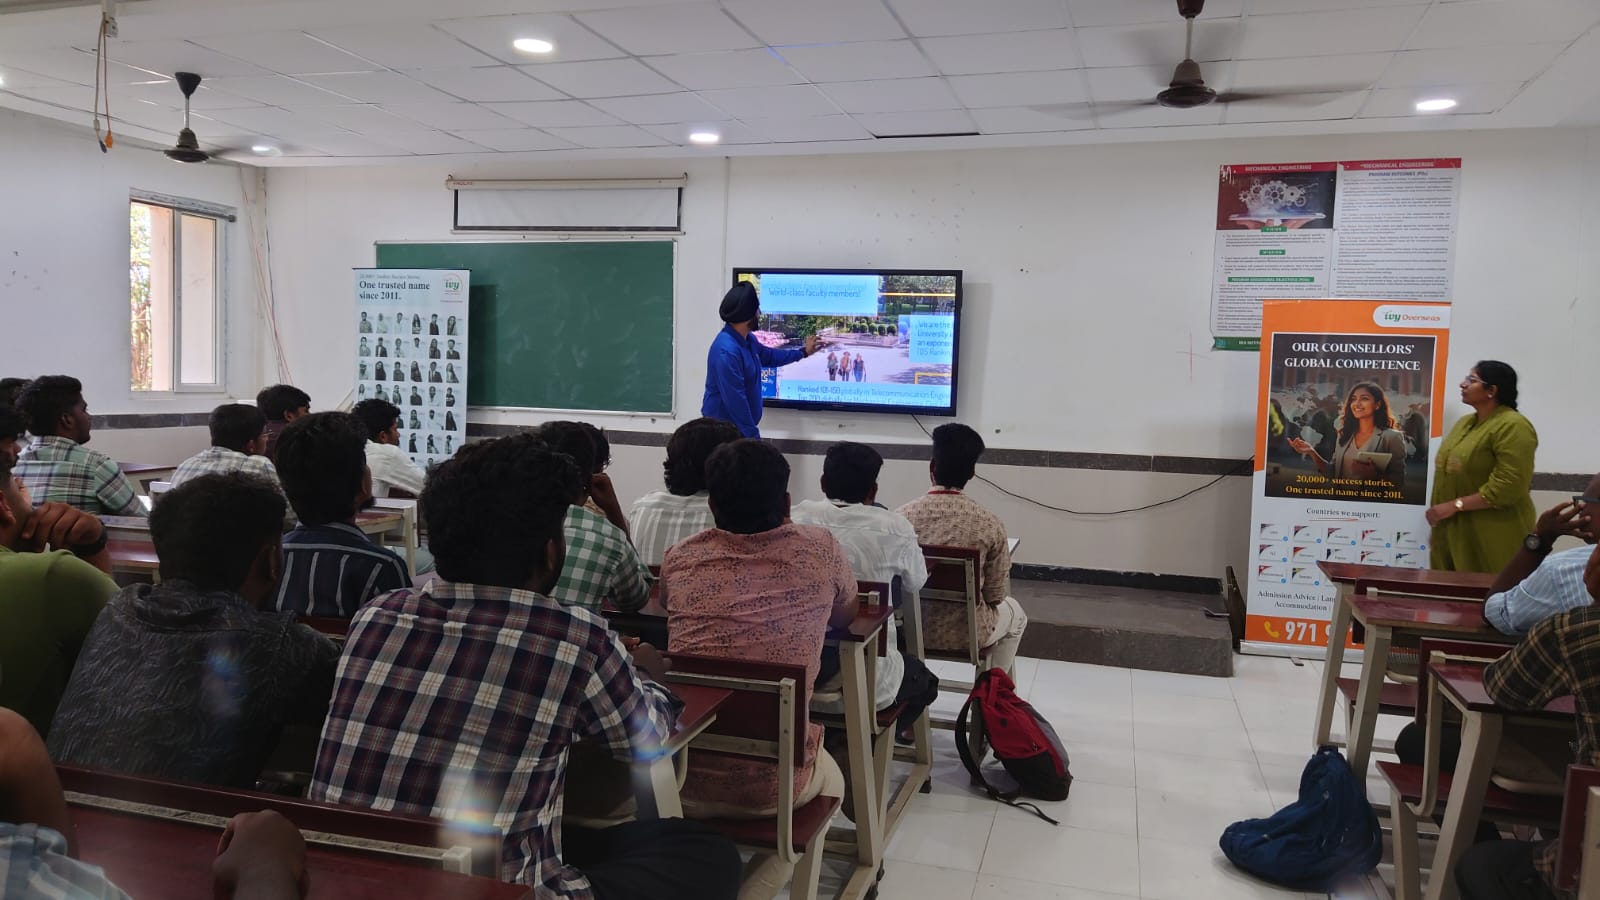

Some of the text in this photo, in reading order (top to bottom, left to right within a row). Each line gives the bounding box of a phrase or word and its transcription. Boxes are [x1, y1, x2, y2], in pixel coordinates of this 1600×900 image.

[360, 280, 376, 289] One
[378, 281, 406, 290] trusted
[444, 280, 460, 290] ivy
[360, 292, 401, 300] since 2011.
[768, 288, 805, 297] World-class
[806, 288, 828, 298] faculty
[1384, 310, 1401, 322] ivy
[1292, 342, 1319, 352] OUR
[1284, 358, 1421, 370] GLOBAL COMPETENCE
[1364, 479, 1395, 487] stories.
[1285, 485, 1303, 494] One
[1304, 487, 1334, 495] trusted
[1360, 489, 1382, 498] since
[1384, 490, 1404, 499] 2011.
[1306, 508, 1339, 516] Countries
[1257, 591, 1292, 599] Admission
[1274, 601, 1327, 611] Accommodation
[1285, 621, 1317, 642] 971
